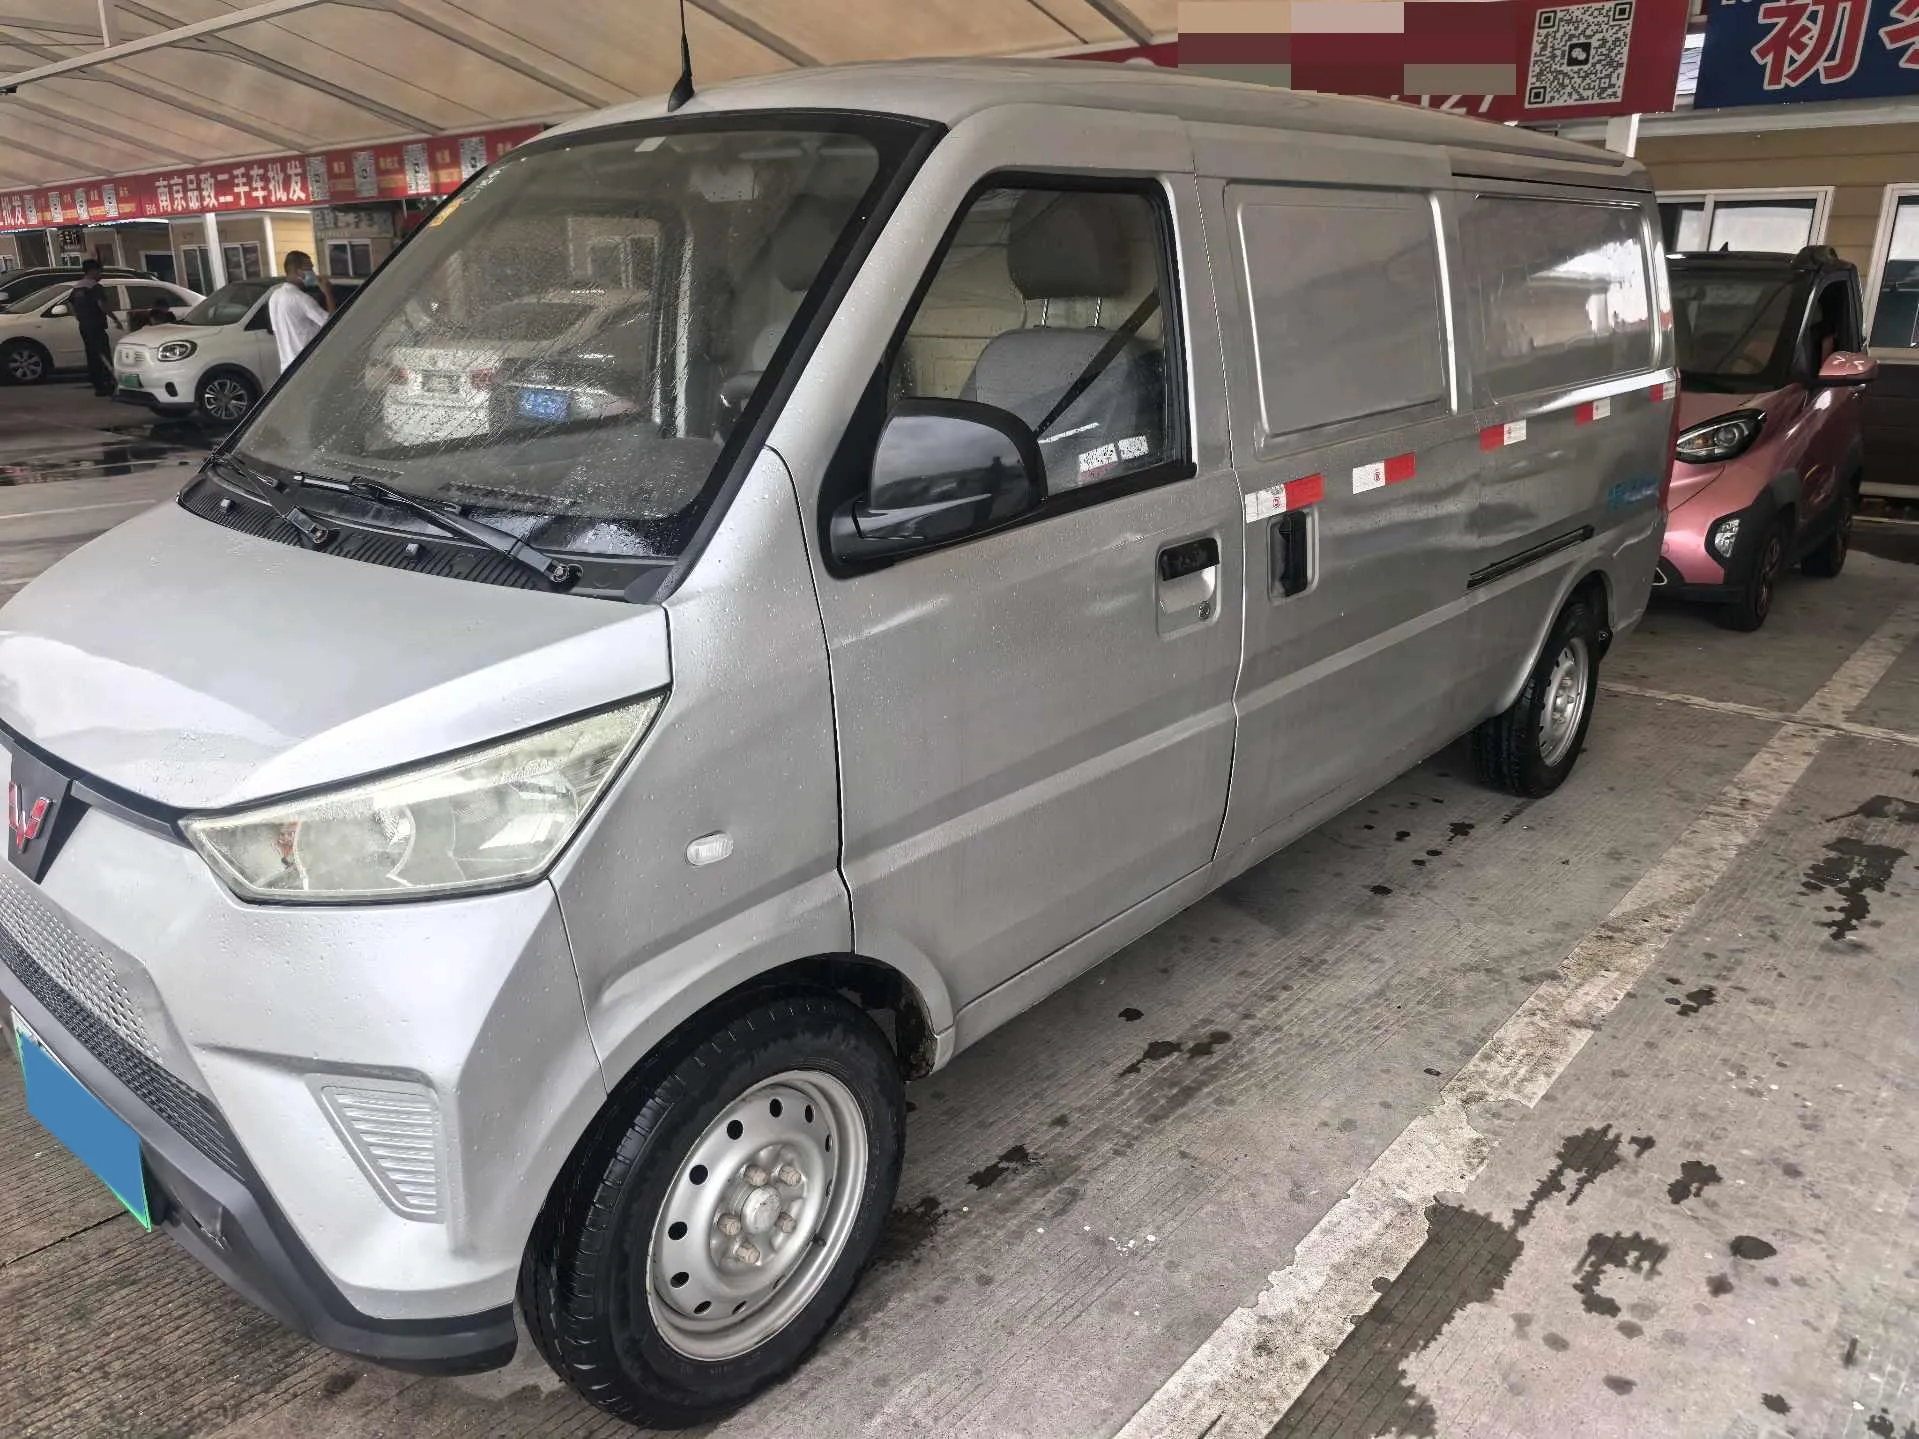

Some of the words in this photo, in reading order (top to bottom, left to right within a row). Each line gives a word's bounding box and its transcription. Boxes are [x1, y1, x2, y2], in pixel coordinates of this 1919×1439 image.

[155, 160, 306, 213] 南京品致二手车批发
